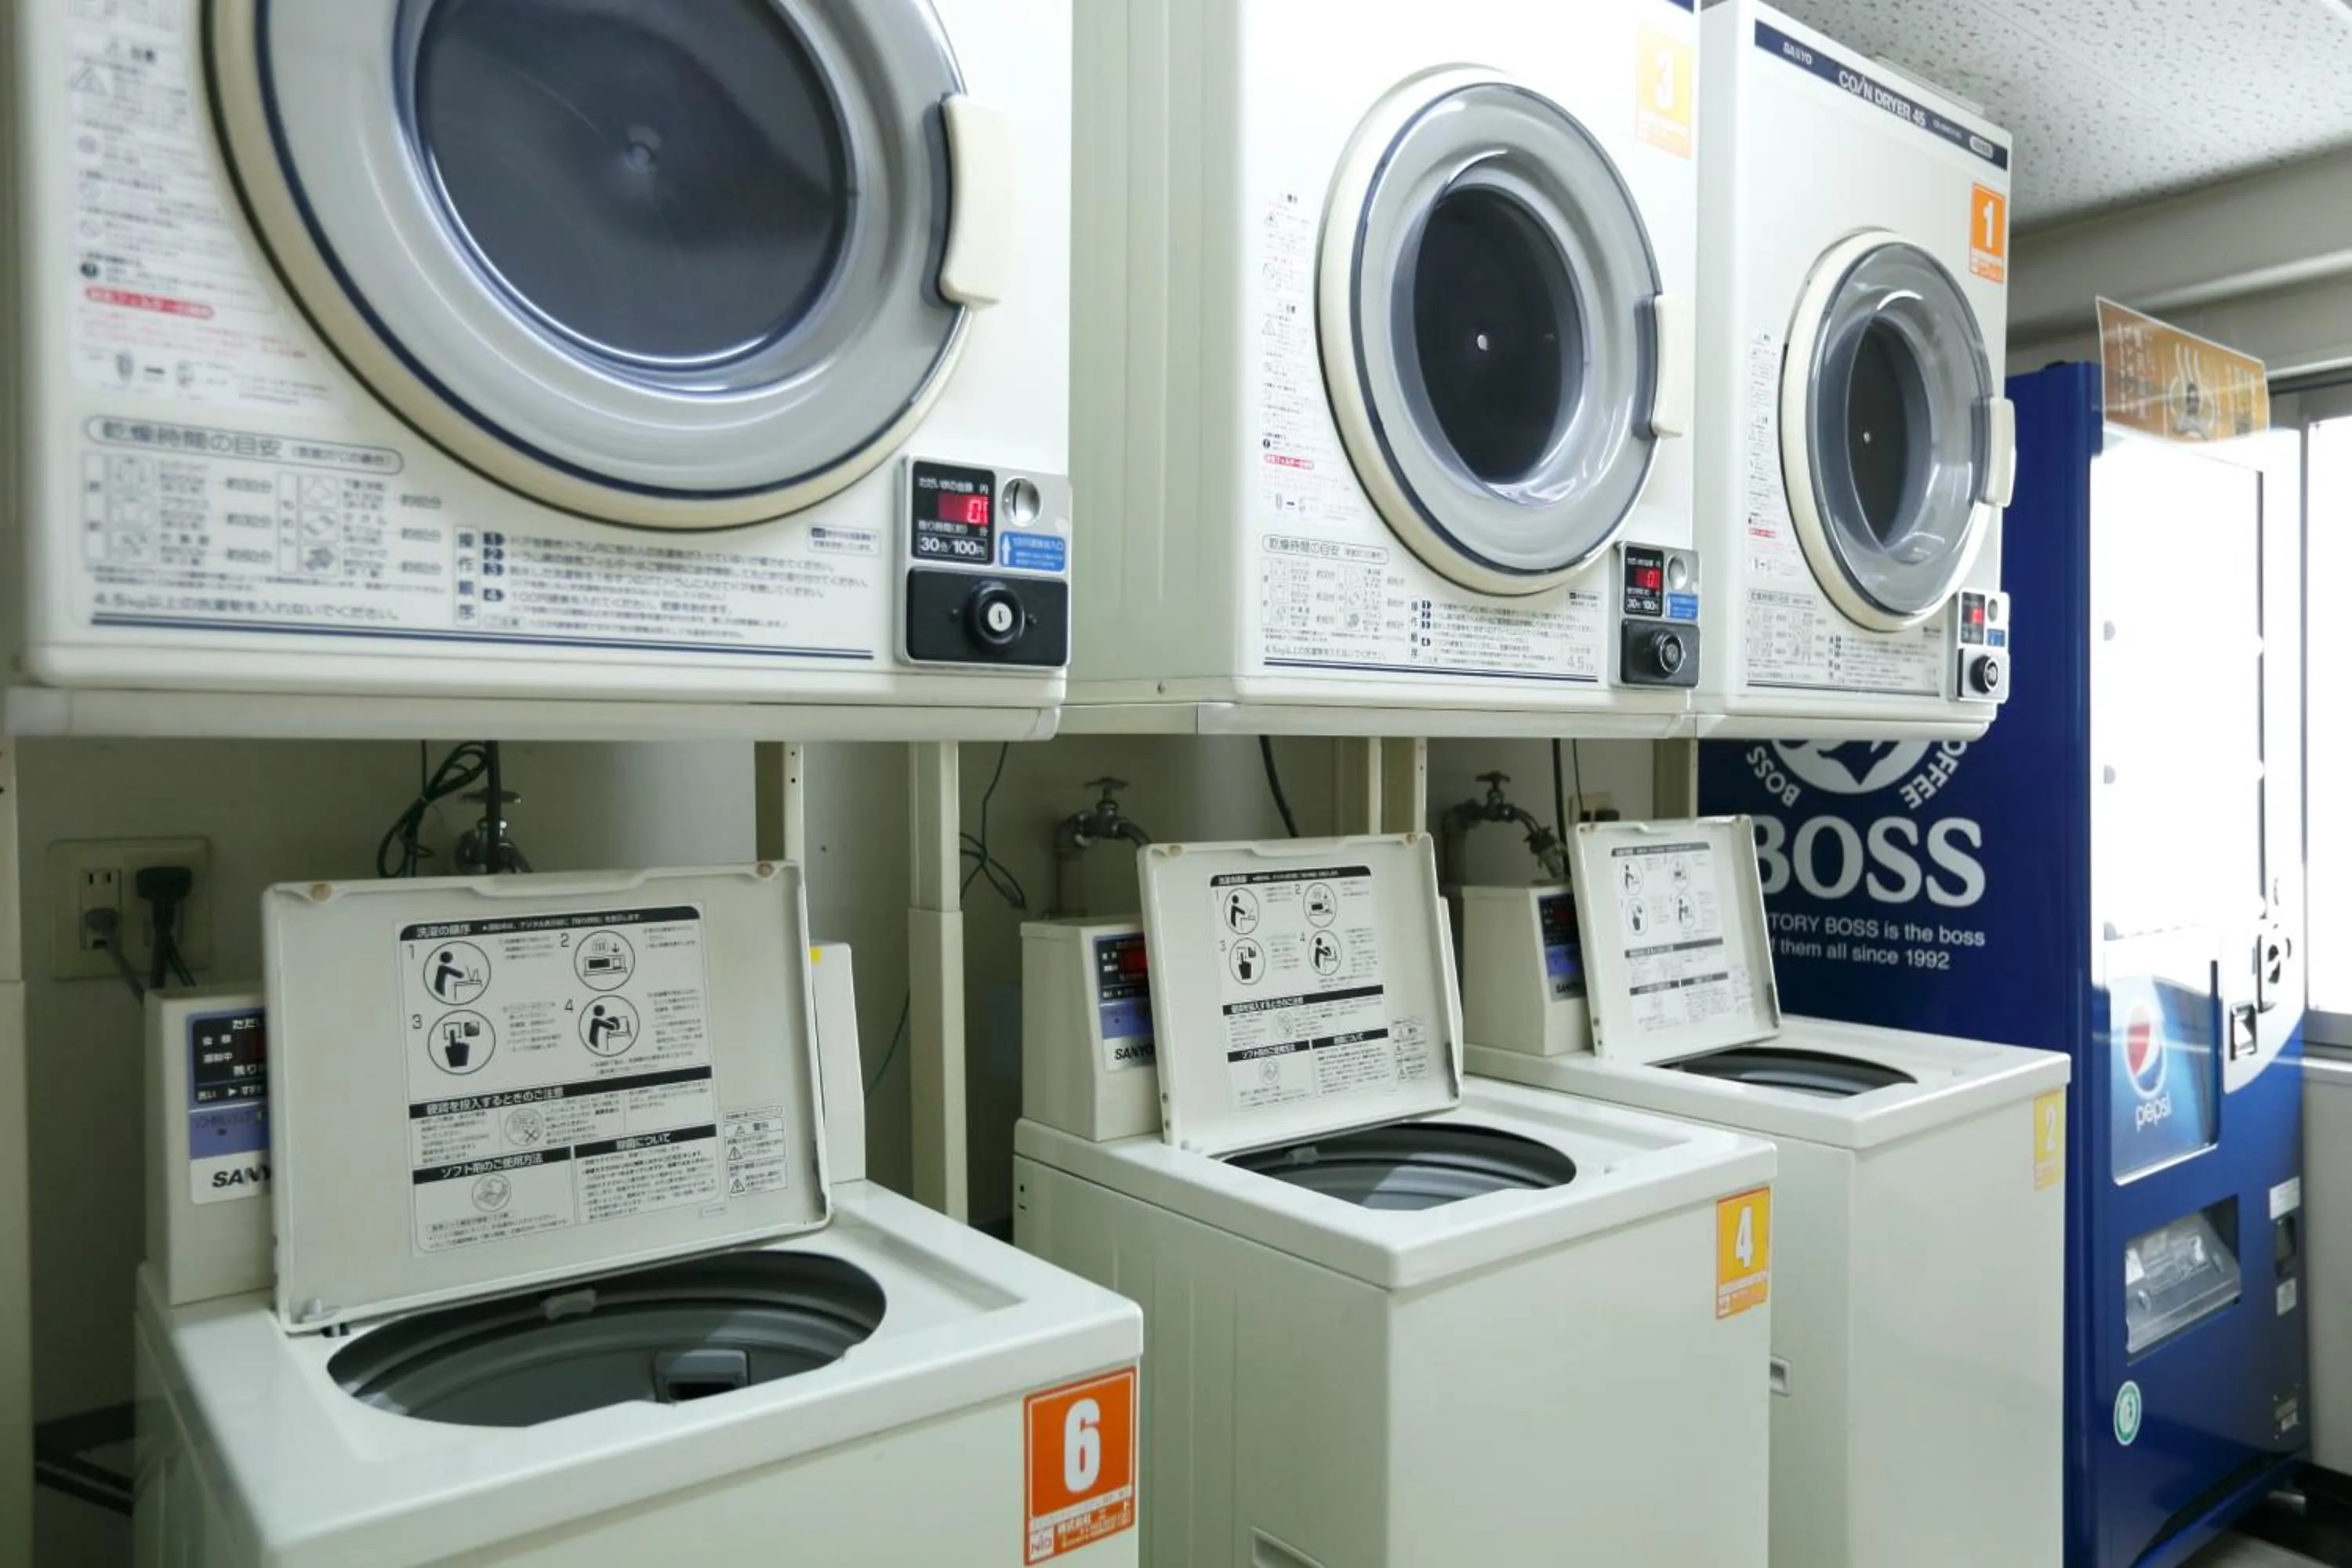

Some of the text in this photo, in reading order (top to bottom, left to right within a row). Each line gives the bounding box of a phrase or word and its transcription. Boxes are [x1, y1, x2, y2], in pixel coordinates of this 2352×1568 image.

[1875, 89, 1911, 120] DRYER
[1983, 200, 1994, 249] 1
[1746, 746, 1802, 808] BOSS
[1751, 815, 1986, 908] BOSS
[561, 933, 571, 948] 2
[1825, 916, 1878, 938] BOSS
[1884, 921, 1900, 938] is
[1904, 924, 1933, 943] the
[1939, 927, 1985, 947] boss
[1780, 938, 1951, 970] them all since 1992
[564, 998, 574, 1013] 4
[412, 1015, 423, 1029] 3
[1115, 1044, 1154, 1060] SANYO
[2135, 1091, 2172, 1132] pepsi
[1735, 1206, 1753, 1268] 4
[1064, 1398, 1100, 1493] 6
